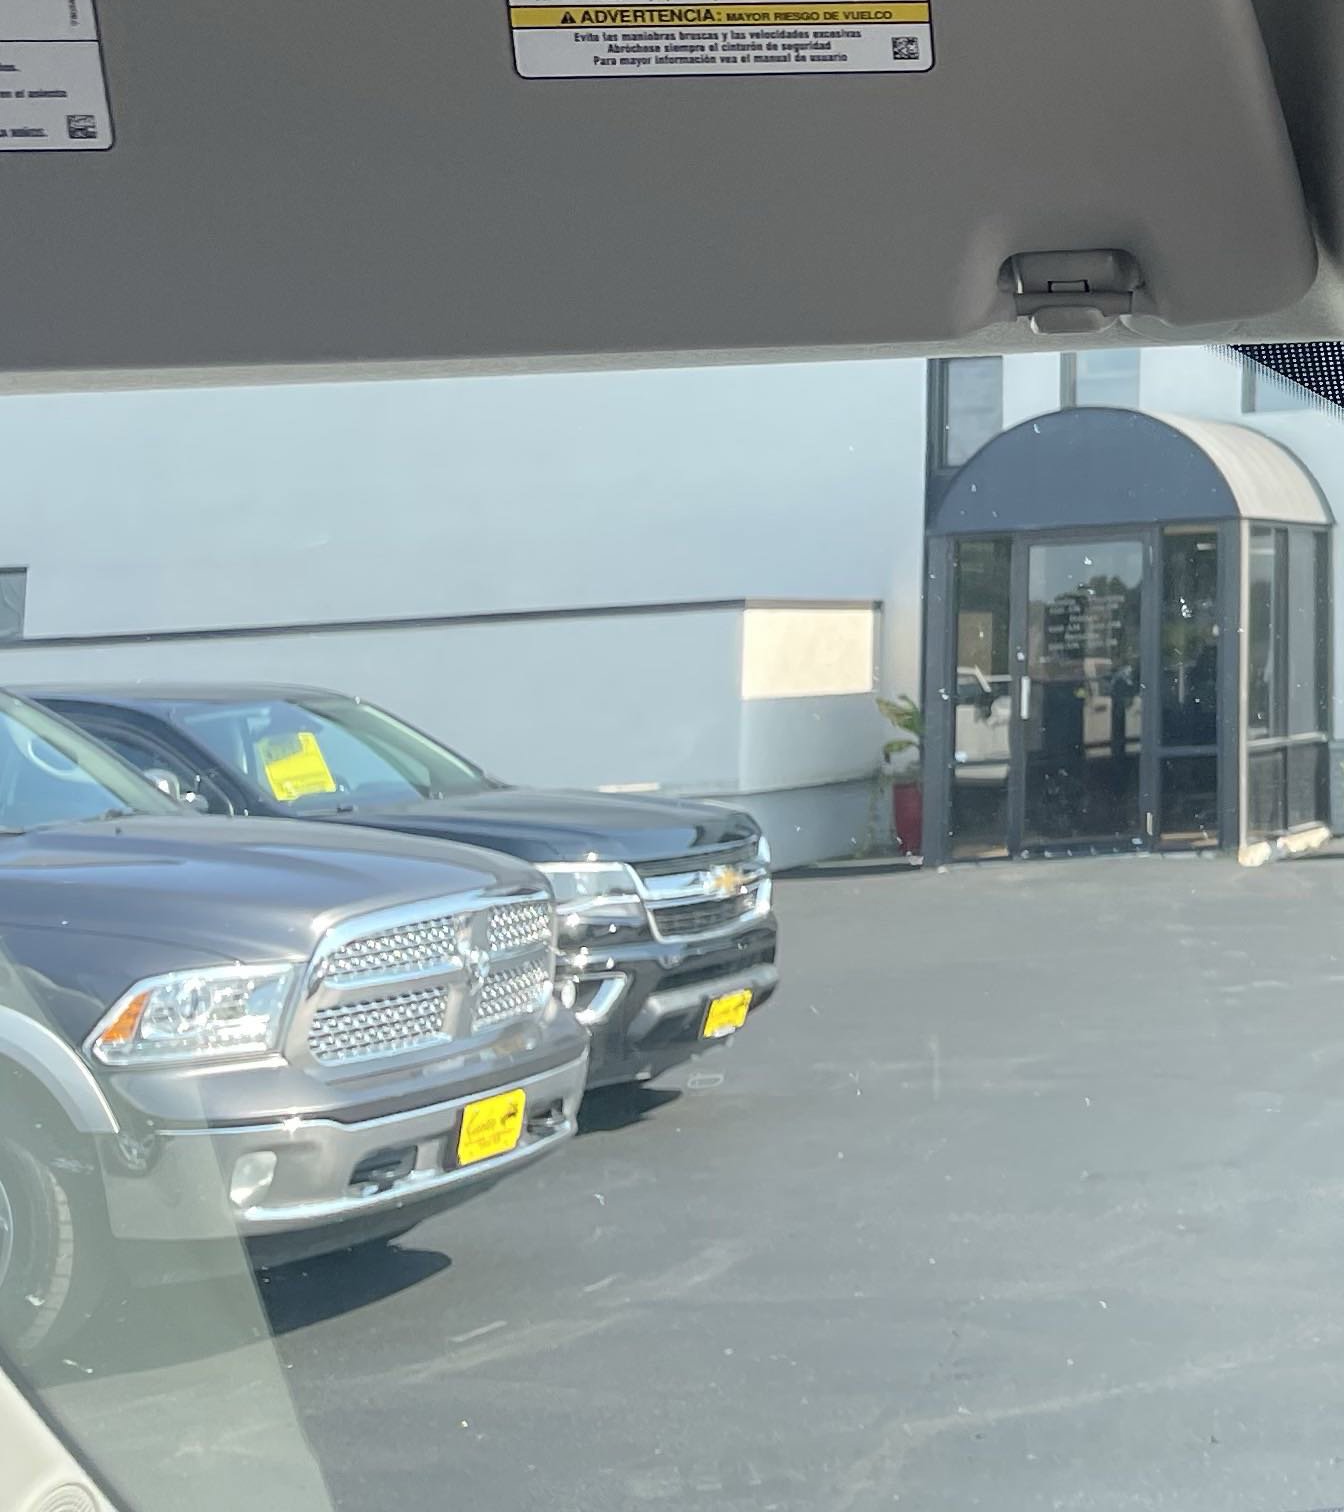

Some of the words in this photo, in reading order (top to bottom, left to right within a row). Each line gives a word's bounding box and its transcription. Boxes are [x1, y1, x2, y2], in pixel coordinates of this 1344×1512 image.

[579, 8, 723, 23] ADVERTENCIA:
[725, 12, 771, 22] MAYOR
[772, 11, 820, 21] RIESGO
[822, 10, 840, 20] DE
[841, 10, 893, 20] VUELCO
